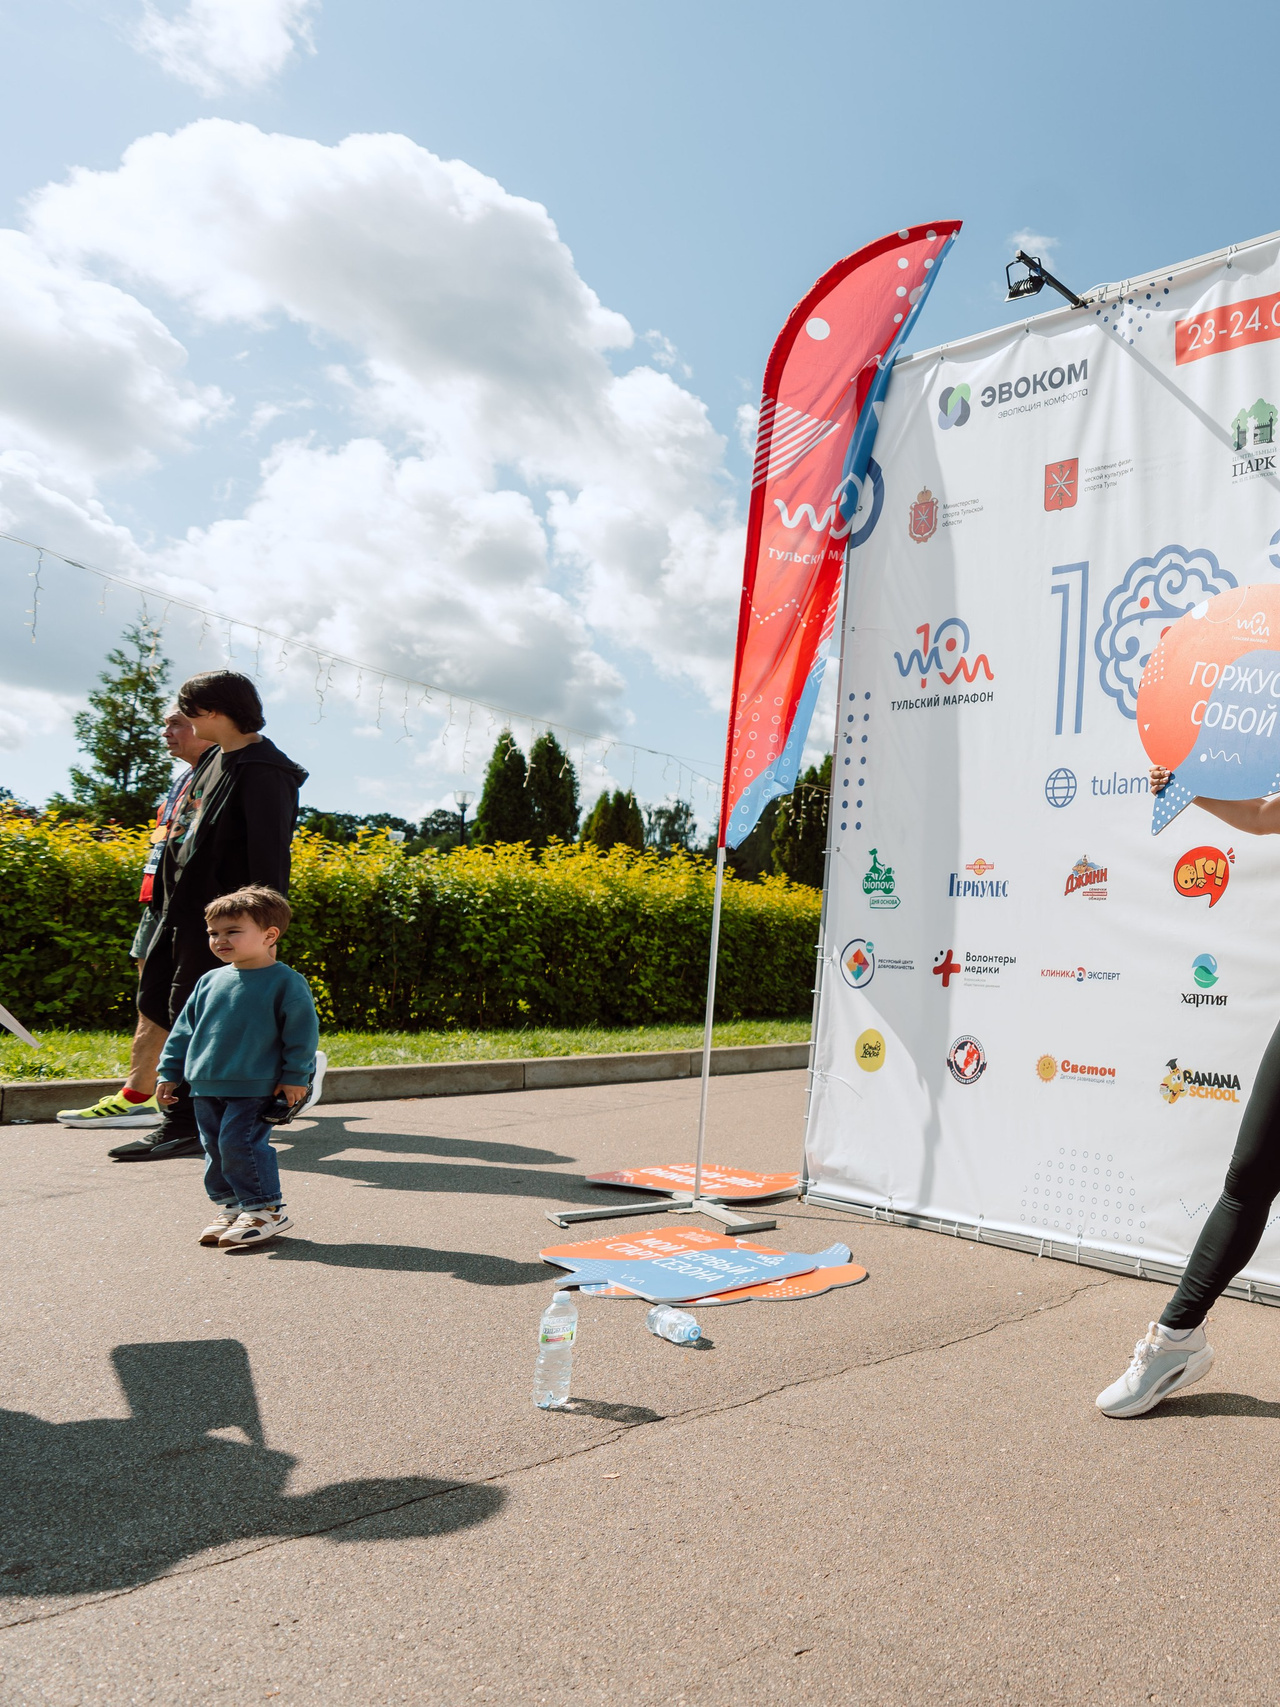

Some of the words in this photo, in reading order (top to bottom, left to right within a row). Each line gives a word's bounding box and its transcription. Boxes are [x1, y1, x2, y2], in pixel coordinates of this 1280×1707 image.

[980, 358, 1088, 408] ЭВОКОМ
[997, 401, 1042, 419] эволюция
[1043, 388, 1088, 408] комфорта
[1232, 455, 1277, 478] ПАРК
[891, 694, 940, 711] ТУЛЬСКИЙ
[943, 691, 994, 706] МАРАФОН
[1190, 699, 1278, 738] СОБОЙ
[863, 877, 895, 890] bionova
[965, 951, 1017, 965] Волонтеры
[964, 965, 1000, 975] медики
[1040, 969, 1076, 979] КЛИНИКА
[1087, 971, 1121, 981] ЭКСПЕРТ
[1181, 992, 1228, 1007] хартия
[1061, 1059, 1116, 1077] Светоч
[1182, 1070, 1241, 1090] BANANA
[1189, 1086, 1240, 1103] SCHOOL
[605, 1242, 664, 1260] СТАРТ
[651, 1257, 725, 1284] СЕЗОНА
[634, 1237, 688, 1253] МОЙ
[673, 1249, 758, 1276] ПЕРВЫЙ
